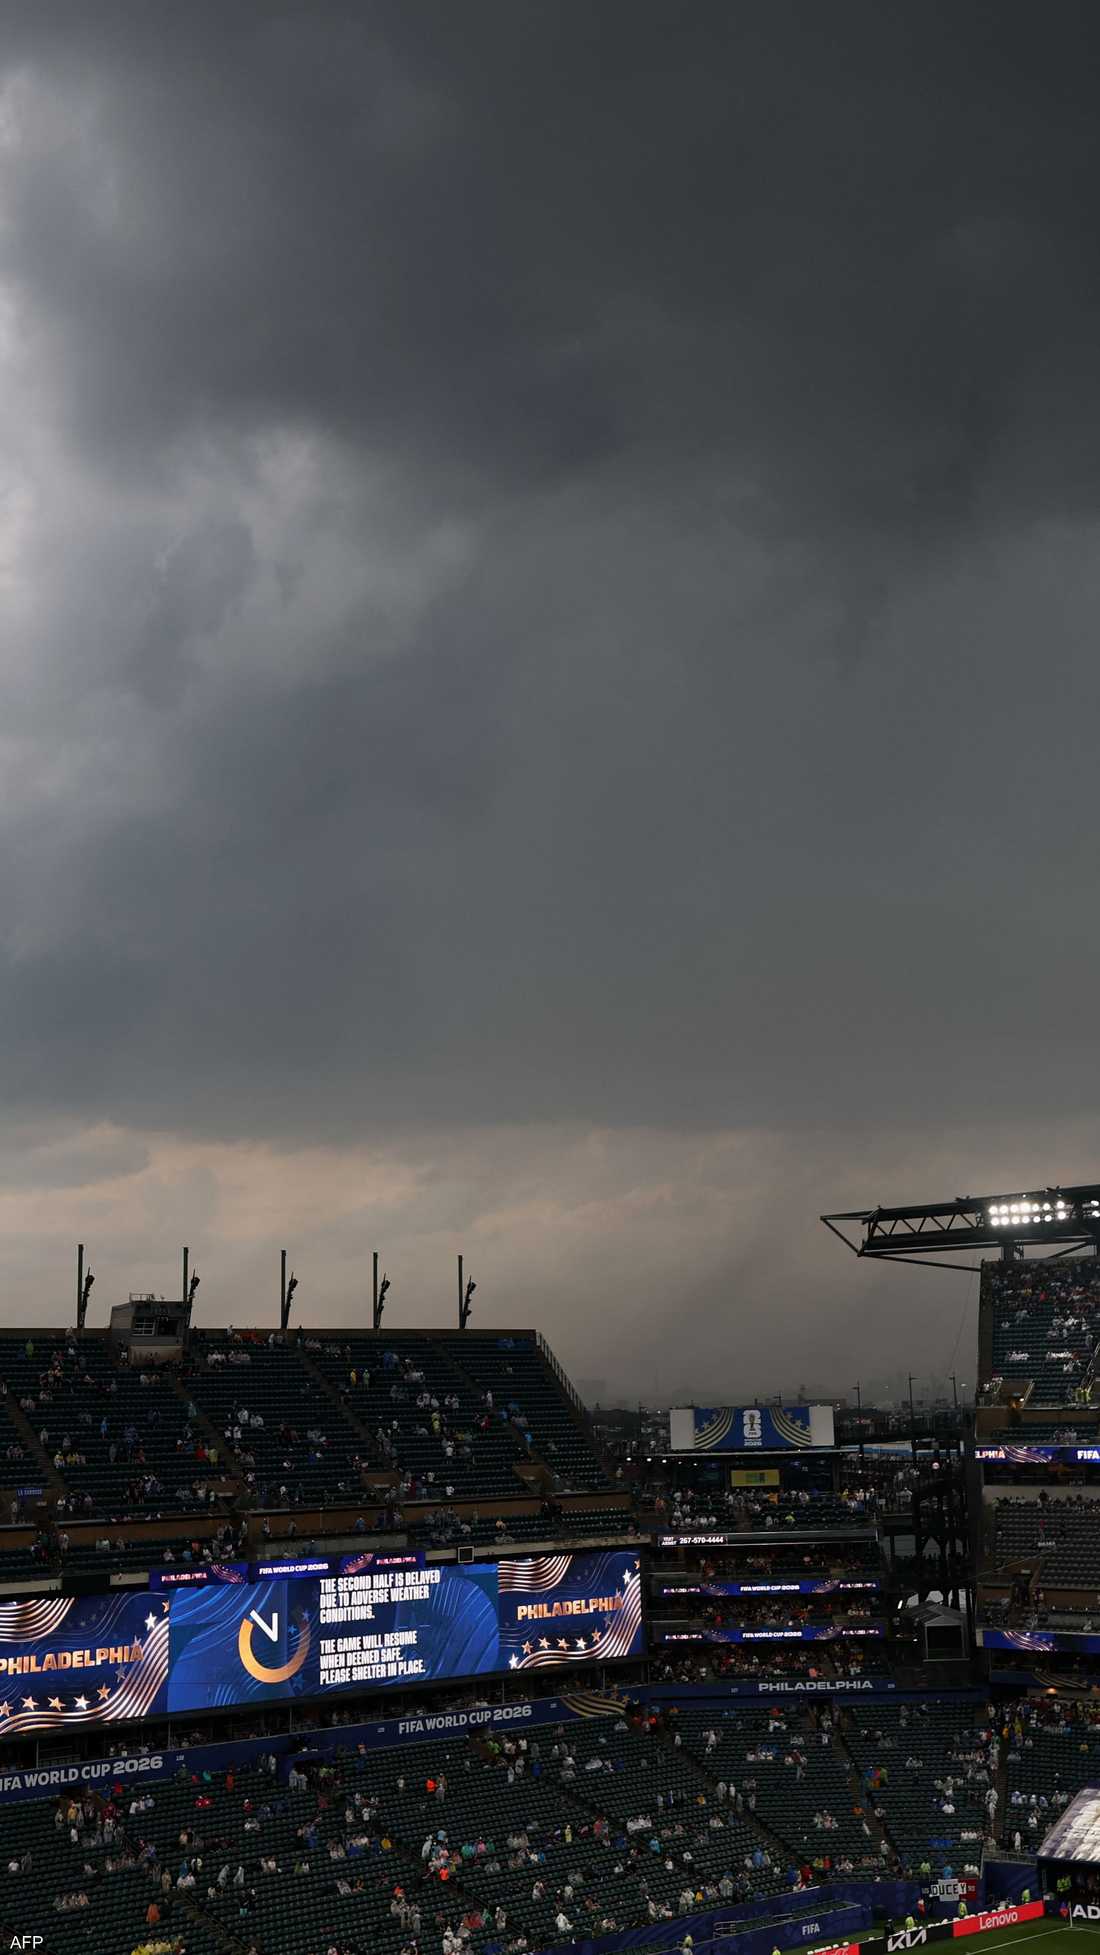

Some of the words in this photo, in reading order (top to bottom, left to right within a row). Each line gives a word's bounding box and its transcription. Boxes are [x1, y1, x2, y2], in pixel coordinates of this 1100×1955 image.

[1077, 1450, 1100, 1460] FIFA
[259, 1567, 273, 1575] FIFA
[274, 1565, 295, 1573] WORLD
[296, 1564, 307, 1572] CUP
[308, 1563, 329, 1571] 2026
[320, 1579, 336, 1593] THE
[337, 1575, 371, 1591] SECOND
[372, 1573, 394, 1589] HALF
[395, 1572, 405, 1587] IS
[405, 1570, 440, 1586] DELAYED
[320, 1593, 337, 1608] DUE
[338, 1592, 349, 1607] TO
[350, 1589, 389, 1605] ADVERSE
[390, 1585, 430, 1602] WEATHER
[320, 1605, 375, 1624] CONDITIONS.
[517, 1596, 624, 1620] PHILADELPHIA
[320, 1639, 336, 1654] THE
[336, 1636, 361, 1652] GAME
[363, 1634, 383, 1649] WILL
[384, 1630, 417, 1647] RESUME
[0, 1645, 144, 1675] PHILADELPHIA
[320, 1653, 345, 1669] WHEN
[346, 1650, 379, 1667] DEEMED
[381, 1647, 403, 1662] SAFE.
[320, 1668, 351, 1685] PLEASE
[352, 1664, 386, 1681] SHELTER
[387, 1662, 397, 1677] IN
[398, 1659, 426, 1676] PLACE.
[758, 1680, 873, 1692] PHILADELPHIA
[399, 1719, 424, 1735] FIFA
[426, 1714, 468, 1730] WORLD
[469, 1711, 492, 1724] CUP
[493, 1705, 532, 1721] 2026
[0, 1776, 22, 1792] IFA
[24, 1768, 79, 1788] WORLD
[81, 1764, 111, 1780] CUP
[113, 1756, 163, 1775] 2026
[931, 1883, 967, 1895] DUCEY
[802, 1922, 820, 1936] FIFA
[979, 1911, 1018, 1930] Lenovo
